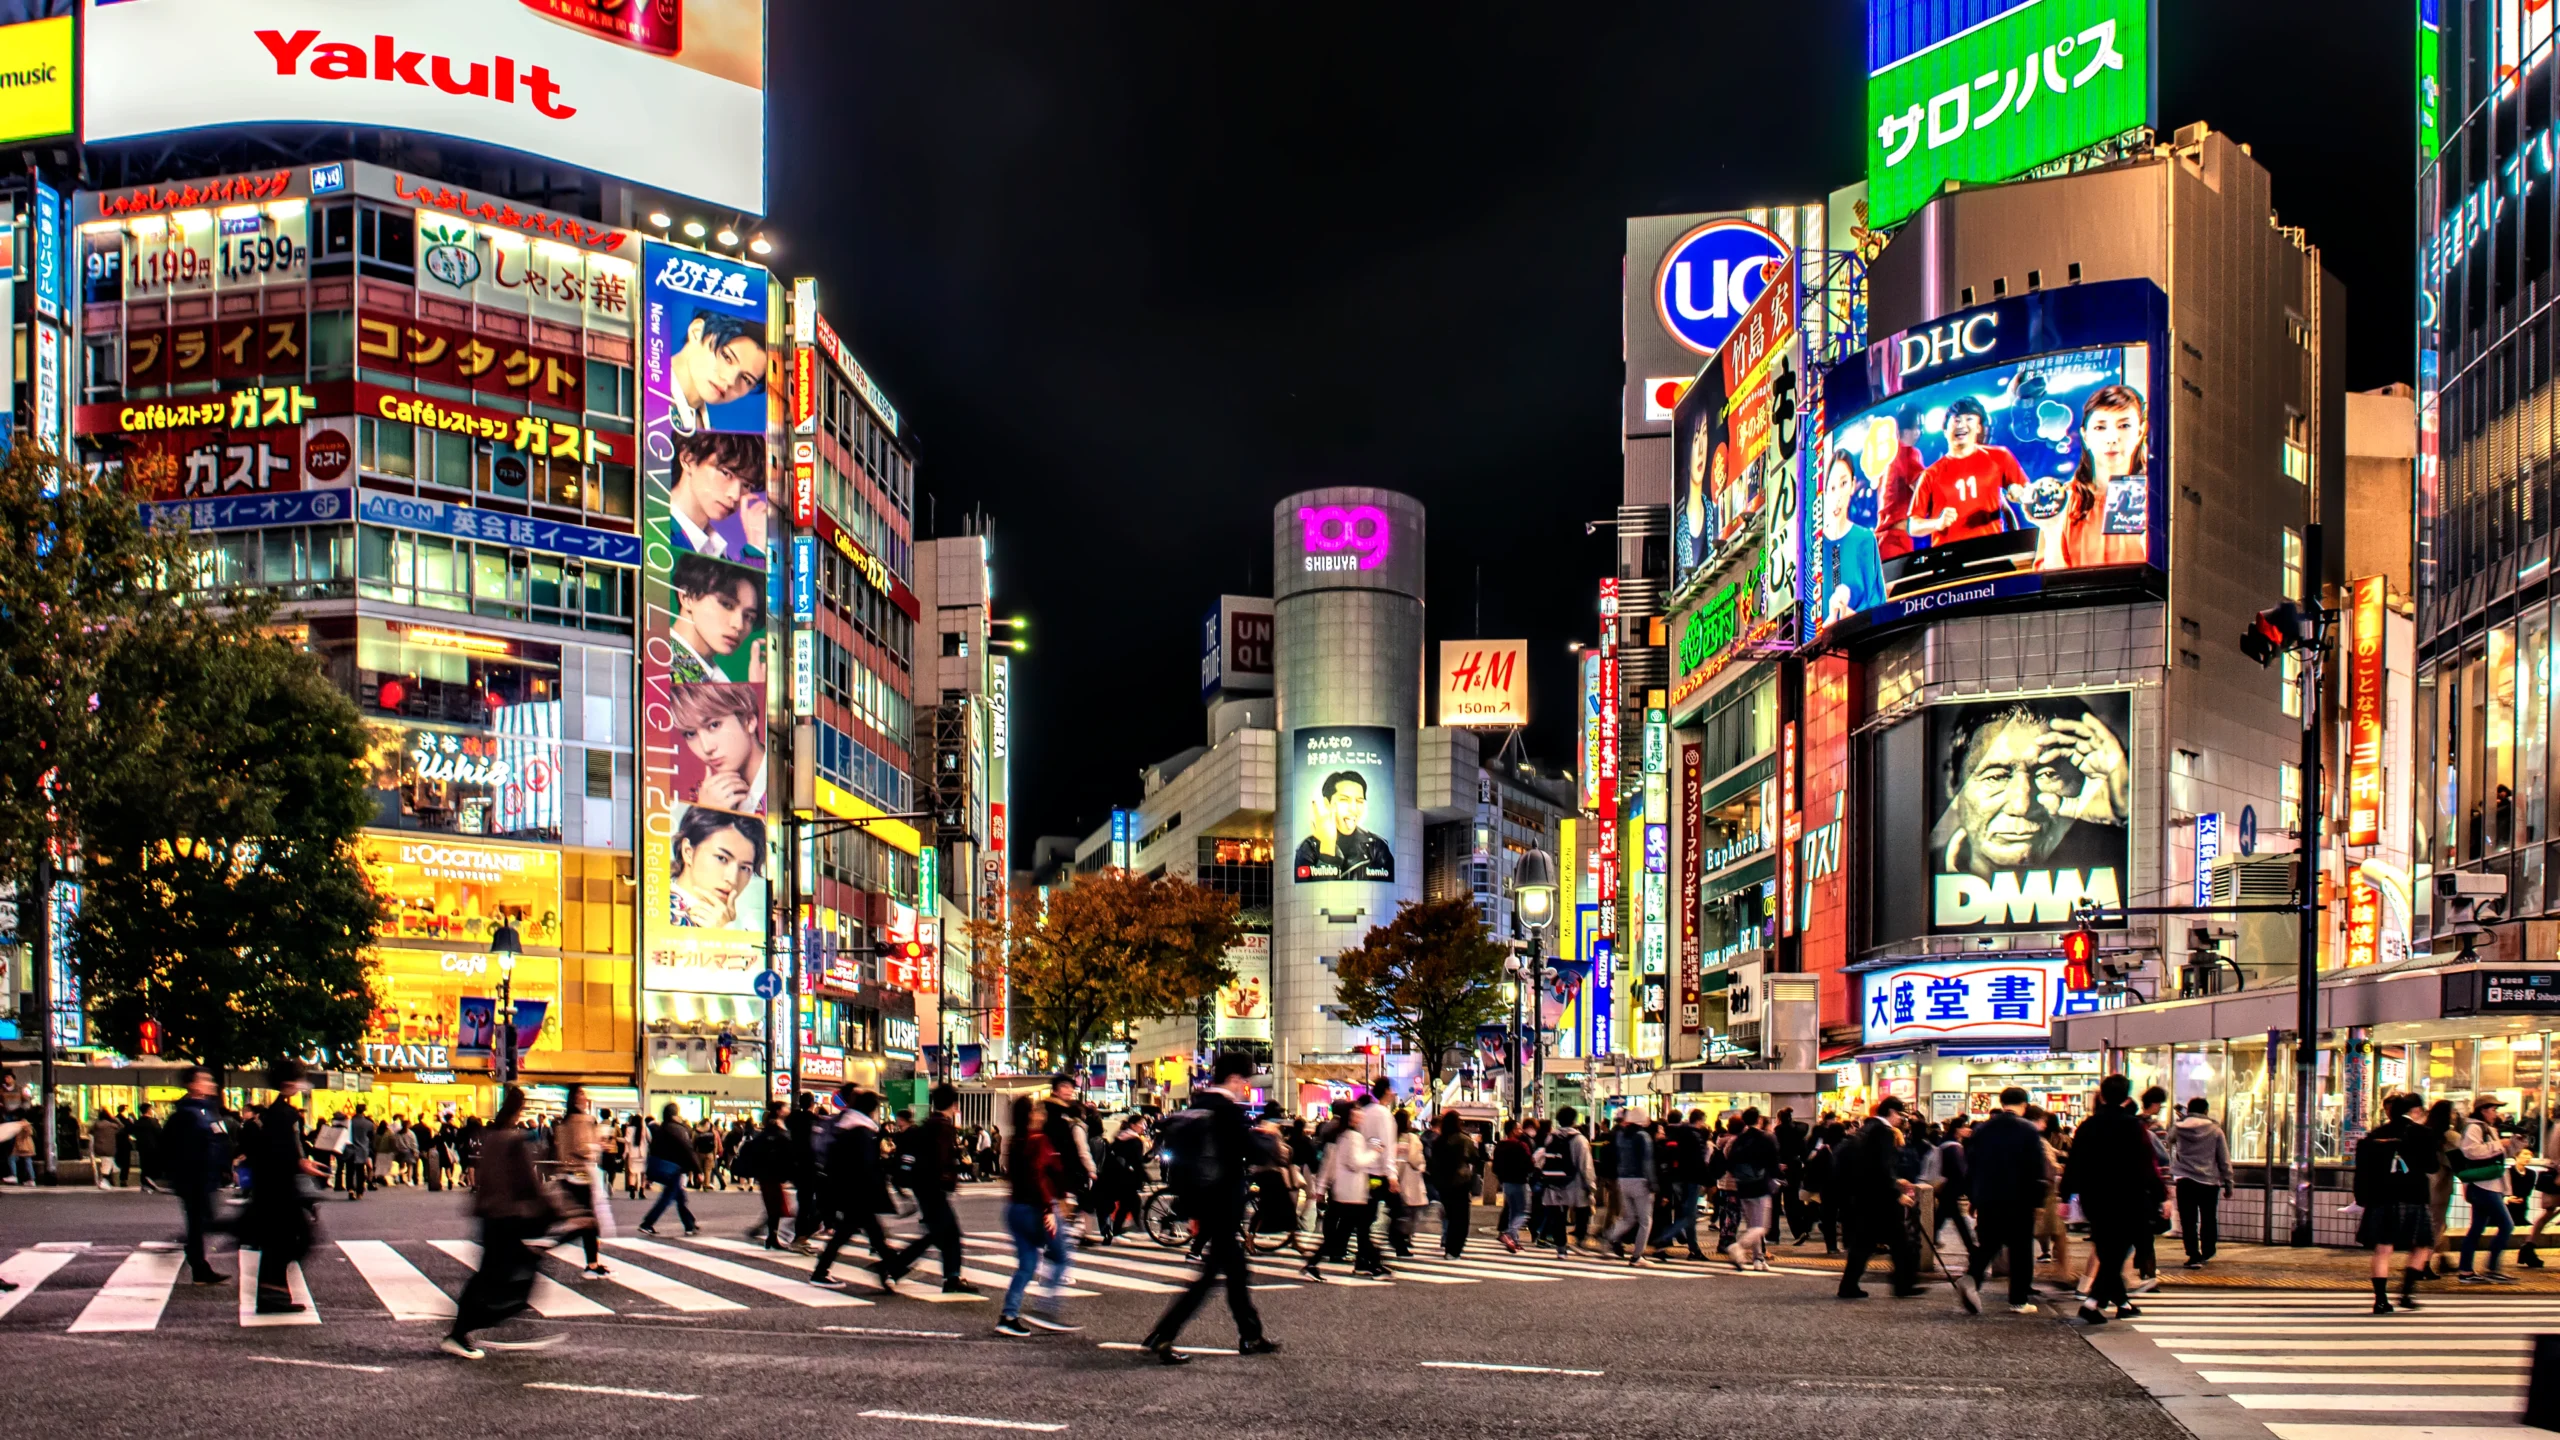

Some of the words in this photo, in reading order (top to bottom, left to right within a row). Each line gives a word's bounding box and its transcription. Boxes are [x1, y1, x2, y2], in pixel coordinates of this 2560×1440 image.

[0, 62, 57, 89] music
[253, 29, 577, 121] Yakult
[1877, 18, 2123, 168] サロンパス
[99, 170, 291, 216] しゃぶしゃぶバイキング
[394, 174, 628, 253] しゃぶしゃぶバイキング
[87, 252, 120, 280] 9F
[218, 235, 307, 282] 1,599円
[495, 249, 628, 314] しゃぶ葉
[650, 301, 663, 335] New
[1731, 312, 1766, 387] 竹島
[1770, 281, 1790, 342] 宏
[129, 322, 301, 375] プライス
[359, 317, 577, 396] コンタクト
[650, 339, 664, 383] Single
[1898, 311, 1999, 377] DHC
[229, 385, 317, 429] ガスト
[310, 453, 347, 468] ガスト
[513, 416, 613, 465] ガスト
[184, 441, 290, 496] ガスト
[647, 387, 698, 594] Revival
[1770, 354, 1797, 599] もんじゃ
[1955, 476, 1978, 502] 11
[368, 497, 435, 523] AEON
[451, 508, 636, 559] 英会話イーオン
[1300, 506, 1390, 570] 109
[1304, 556, 1358, 571] SHIBUYA
[1903, 596, 1935, 616] DHC
[1936, 583, 1996, 607] Channel
[1238, 620, 1271, 641] UN
[647, 602, 696, 734] Love
[797, 637, 811, 709] 渋谷駅前ビル
[993, 664, 1006, 691] BC
[1238, 645, 1274, 669] QL
[1450, 649, 1517, 693] H&M
[1457, 702, 1497, 715] 150m
[1306, 751, 1384, 767] 好きが、ここに。
[1307, 735, 1353, 750] みんなの
[410, 749, 511, 787] Ushi8
[645, 743, 680, 838] 11.20
[2349, 741, 2378, 836] 三千里
[401, 844, 523, 873] L'OCCITANE
[1310, 865, 1338, 877] YouTube
[1685, 781, 1700, 924] ウィンターフルーツギフト
[1705, 829, 1759, 871] Euphoria
[647, 841, 665, 919] Release
[1934, 867, 2123, 927] DMM
[440, 953, 488, 979] Café
[1870, 974, 2099, 1029] 大盛堂書店
[2502, 989, 2536, 1001] 渋谷駅
[884, 1017, 916, 1049] LUSH
